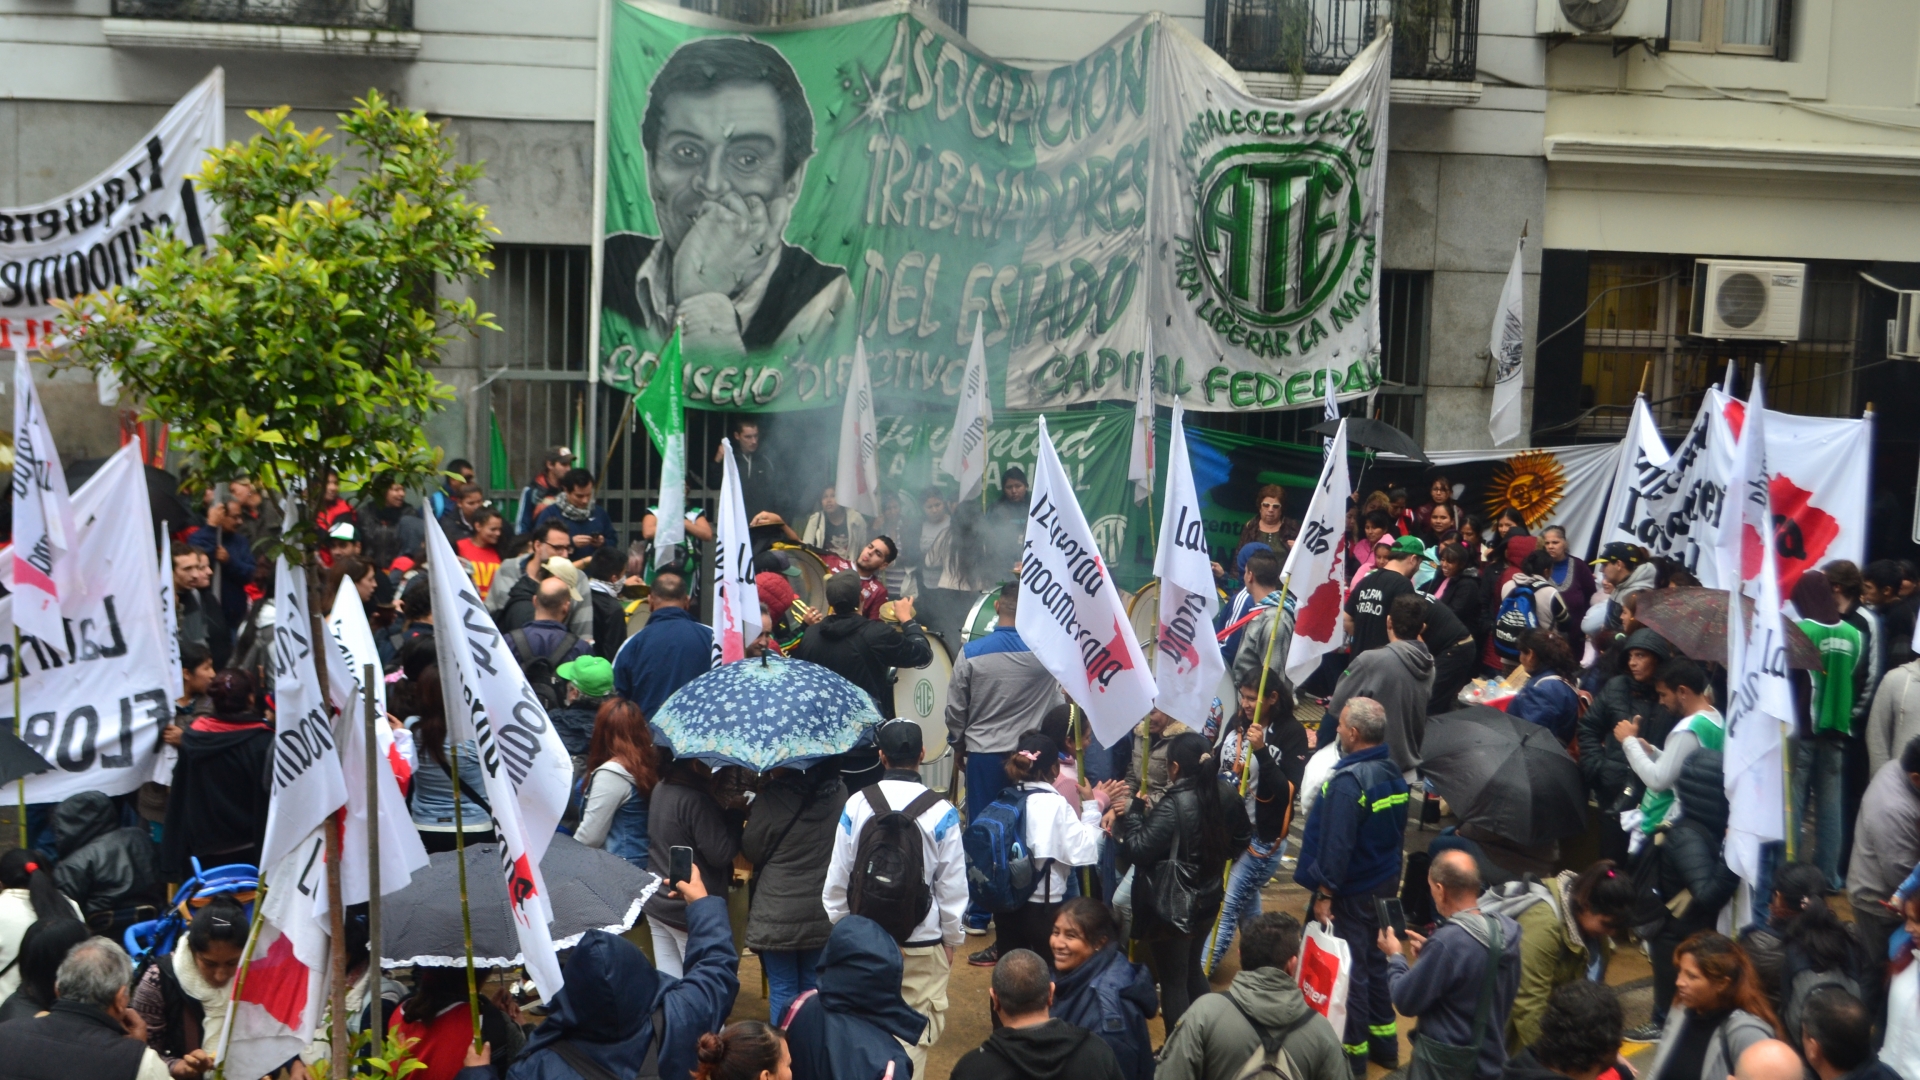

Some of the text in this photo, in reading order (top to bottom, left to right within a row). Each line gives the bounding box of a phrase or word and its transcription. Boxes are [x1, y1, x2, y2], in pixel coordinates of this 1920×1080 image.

[880, 17, 1154, 148] ASOCIACION
[1174, 233, 1203, 302] PARA
[1196, 297, 1291, 357] LIBERAR
[1300, 318, 1328, 353] LA
[1201, 160, 1343, 313] ATE
[860, 248, 1138, 350] DEL ESTADO
[915, 682, 933, 713] ATE
